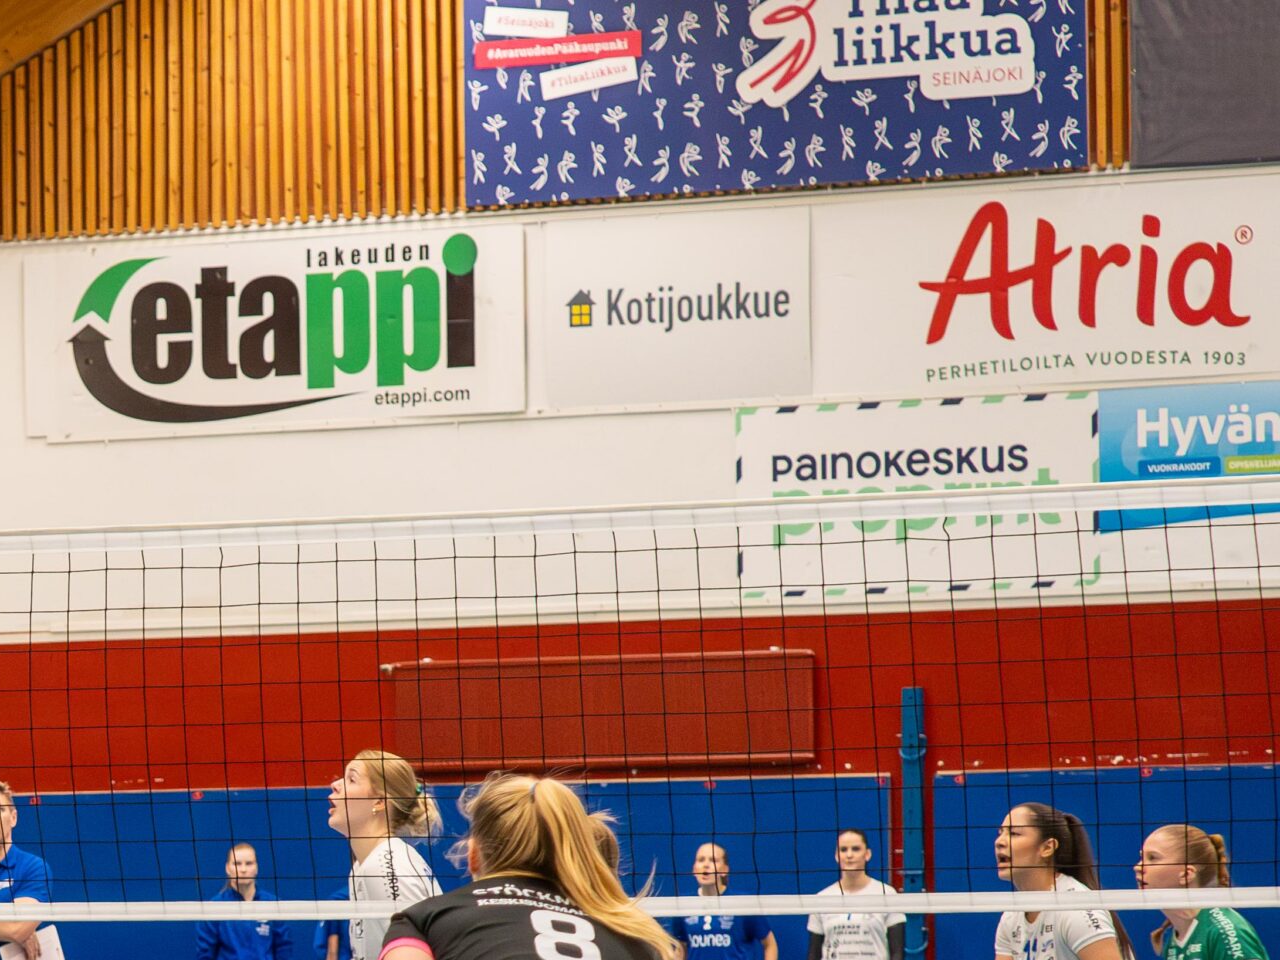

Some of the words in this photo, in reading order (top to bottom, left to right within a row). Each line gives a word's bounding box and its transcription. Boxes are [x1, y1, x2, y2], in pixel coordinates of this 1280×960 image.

[497, 14, 555, 30] #Seinäjoki
[486, 38, 629, 60] #AvaruudenPääkaupunki
[833, 20, 1022, 68] liikkua
[932, 66, 1024, 88] SEINÄJOKI
[306, 242, 430, 268] lakeuden
[918, 201, 1252, 344] Atria
[130, 233, 478, 389] etappi
[606, 281, 791, 332] Kotijoukkue
[926, 354, 1075, 382] PERHETILOILTA
[1086, 350, 1192, 366] VUODESTA
[1203, 350, 1247, 366] 1903
[375, 387, 471, 407] etappi.com
[1136, 403, 1280, 457] Hyvän
[1208, 907, 1245, 960] POWERPARK
